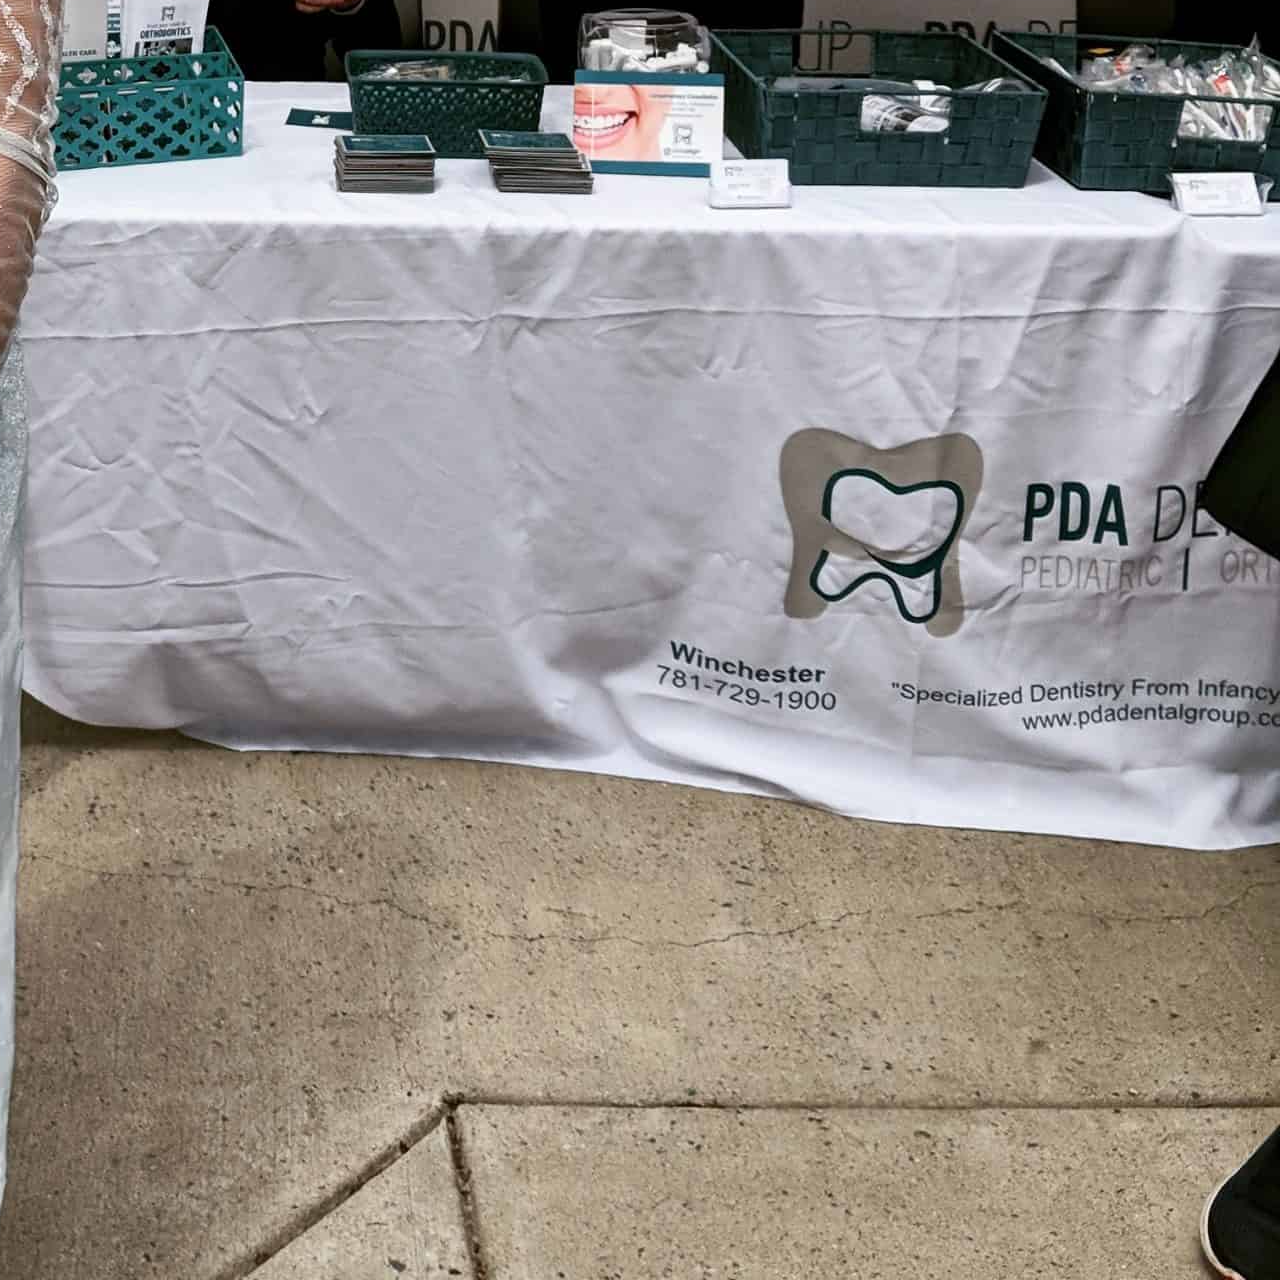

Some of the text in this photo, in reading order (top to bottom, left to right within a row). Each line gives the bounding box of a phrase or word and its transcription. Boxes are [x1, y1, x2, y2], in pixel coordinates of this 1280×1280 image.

[140, 26, 191, 39] ORTHODONTICS
[1023, 481, 1233, 546] PDA DE
[1021, 554, 1163, 592] PEDIATRIC
[670, 640, 826, 683] Winchester
[657, 664, 837, 711] 781-729-1900
[892, 679, 1280, 708] "Specialized Dentistry From Infancy
